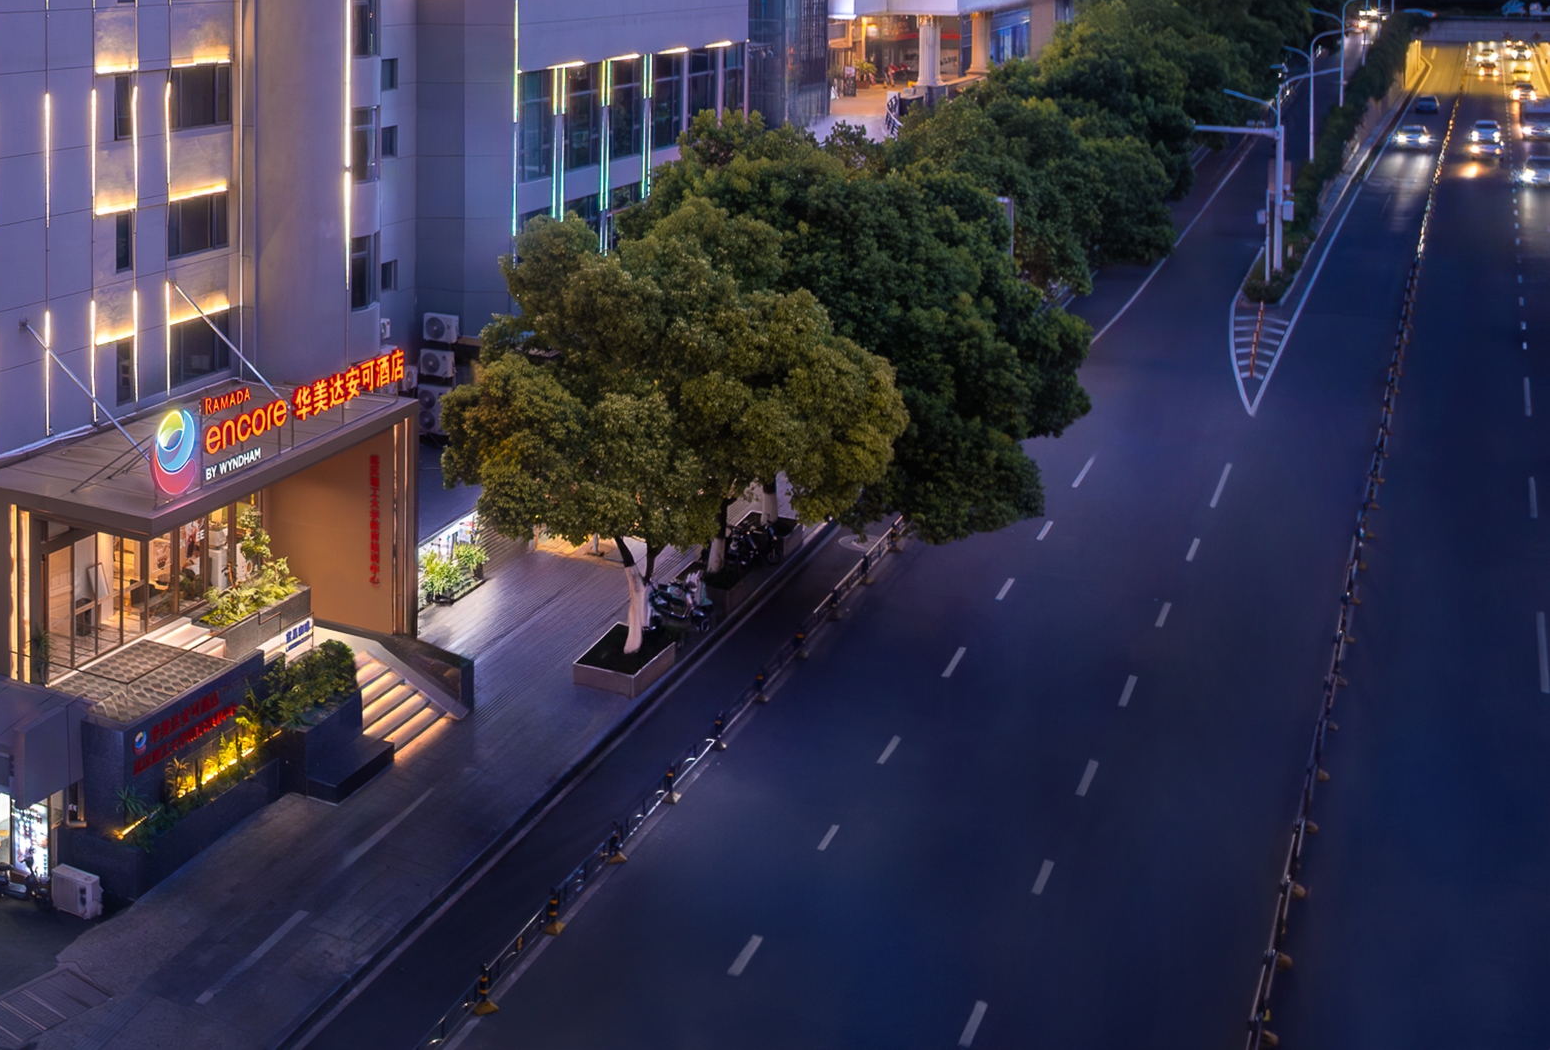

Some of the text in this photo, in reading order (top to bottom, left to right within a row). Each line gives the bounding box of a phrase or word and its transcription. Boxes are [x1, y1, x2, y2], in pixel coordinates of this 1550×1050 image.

[204, 387, 251, 416] RAMADA
[292, 349, 405, 421] 华美达安可酒店
[204, 399, 288, 455] encore
[205, 448, 262, 481] BY WYNDHAM
